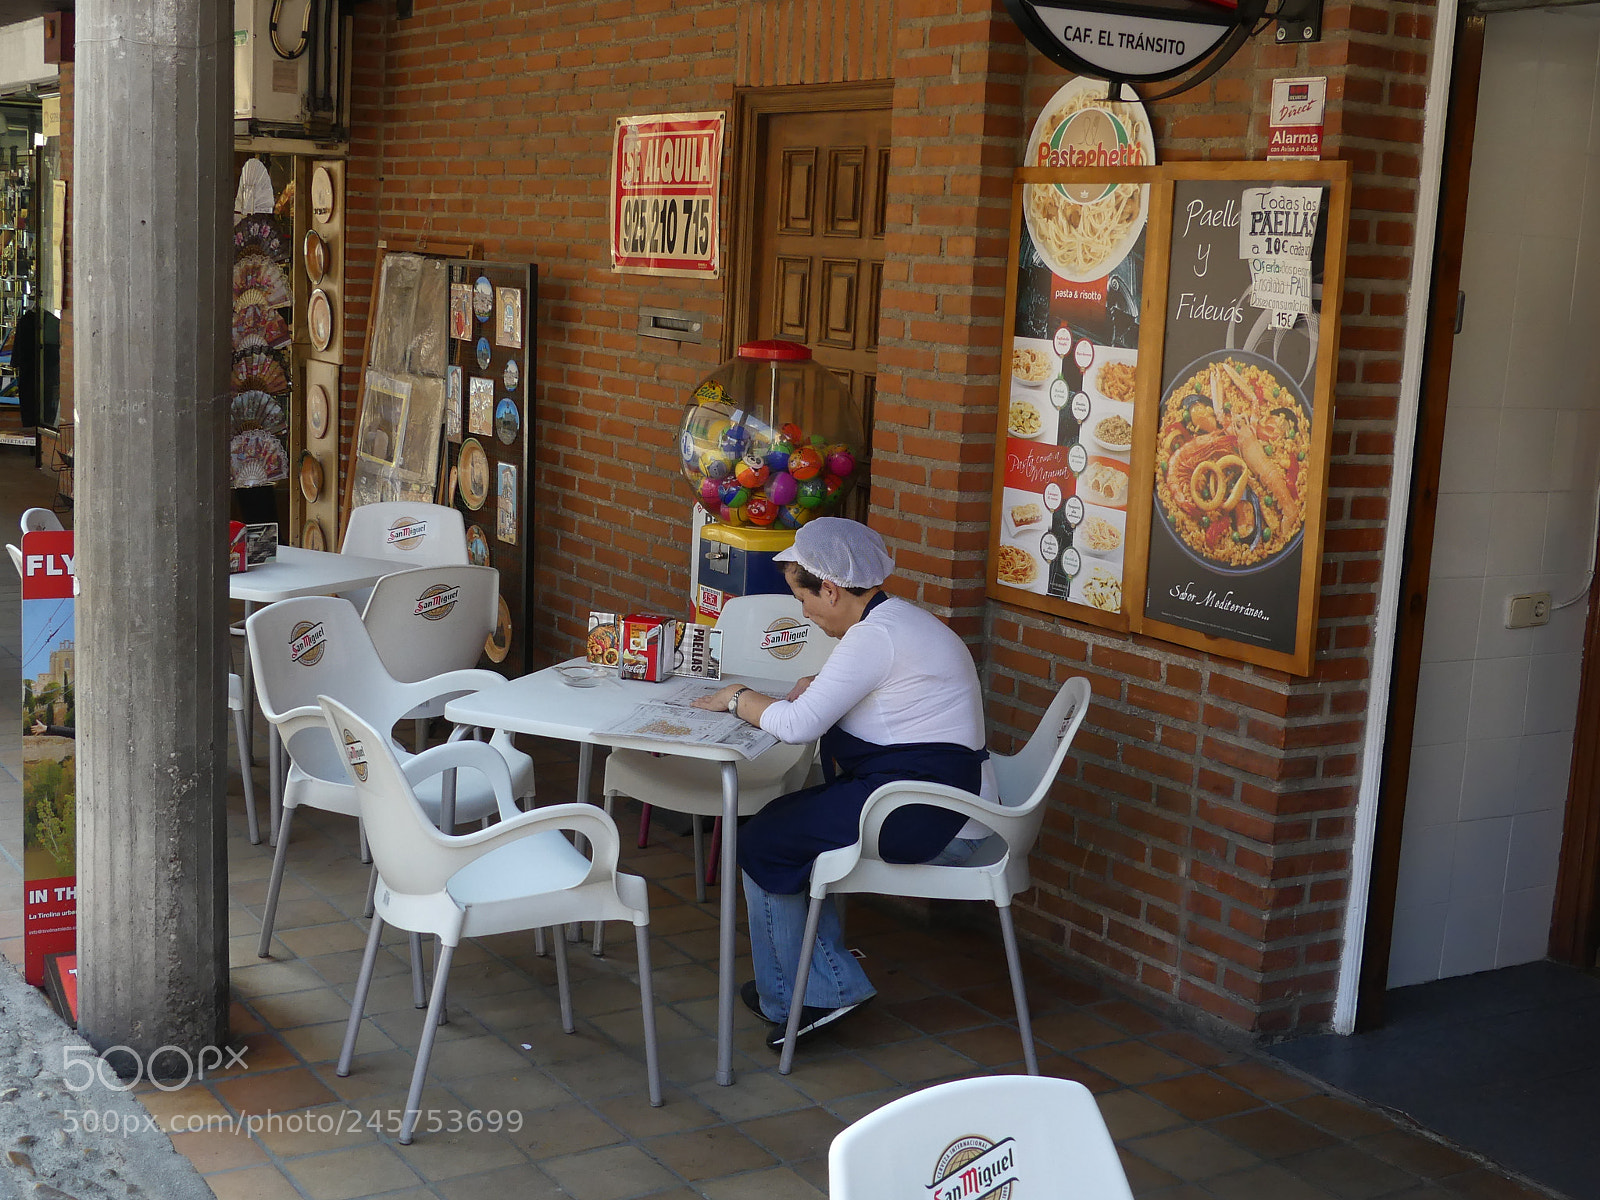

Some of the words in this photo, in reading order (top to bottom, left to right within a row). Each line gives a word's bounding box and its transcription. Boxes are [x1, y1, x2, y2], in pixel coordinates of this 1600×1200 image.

[1063, 25, 1093, 44] CAF.
[1097, 30, 1114, 46] EL
[1118, 32, 1186, 55] TRÁNSITO
[1279, 99, 1317, 121] Direct
[1271, 130, 1319, 144] Alarma
[624, 139, 641, 183] SE
[643, 137, 710, 184] ALQUILA
[1038, 141, 1141, 166] Pastaghetti
[1256, 192, 1300, 211] Todas
[1302, 196, 1317, 211] las
[623, 199, 647, 253] 925
[649, 198, 678, 254] 210
[682, 199, 710, 255] 715
[1249, 211, 1318, 237] PAELLAS
[1194, 244, 1211, 276] y
[1251, 244, 1260, 255] a
[1055, 289, 1072, 300] pasta
[1073, 290, 1079, 299] &
[1079, 289, 1102, 301] risotto
[1175, 293, 1244, 323] Fideuás
[1276, 312, 1293, 328] 15€
[26, 554, 75, 576] FLY
[1169, 582, 1197, 602] Sabor
[691, 628, 705, 673] PAELLAS
[29, 890, 48, 904] IN
[38, 911, 60, 919] Tirolina
[937, 1155, 950, 1178] CERVEZA
[951, 1140, 988, 1153] INTERNACIONAL
